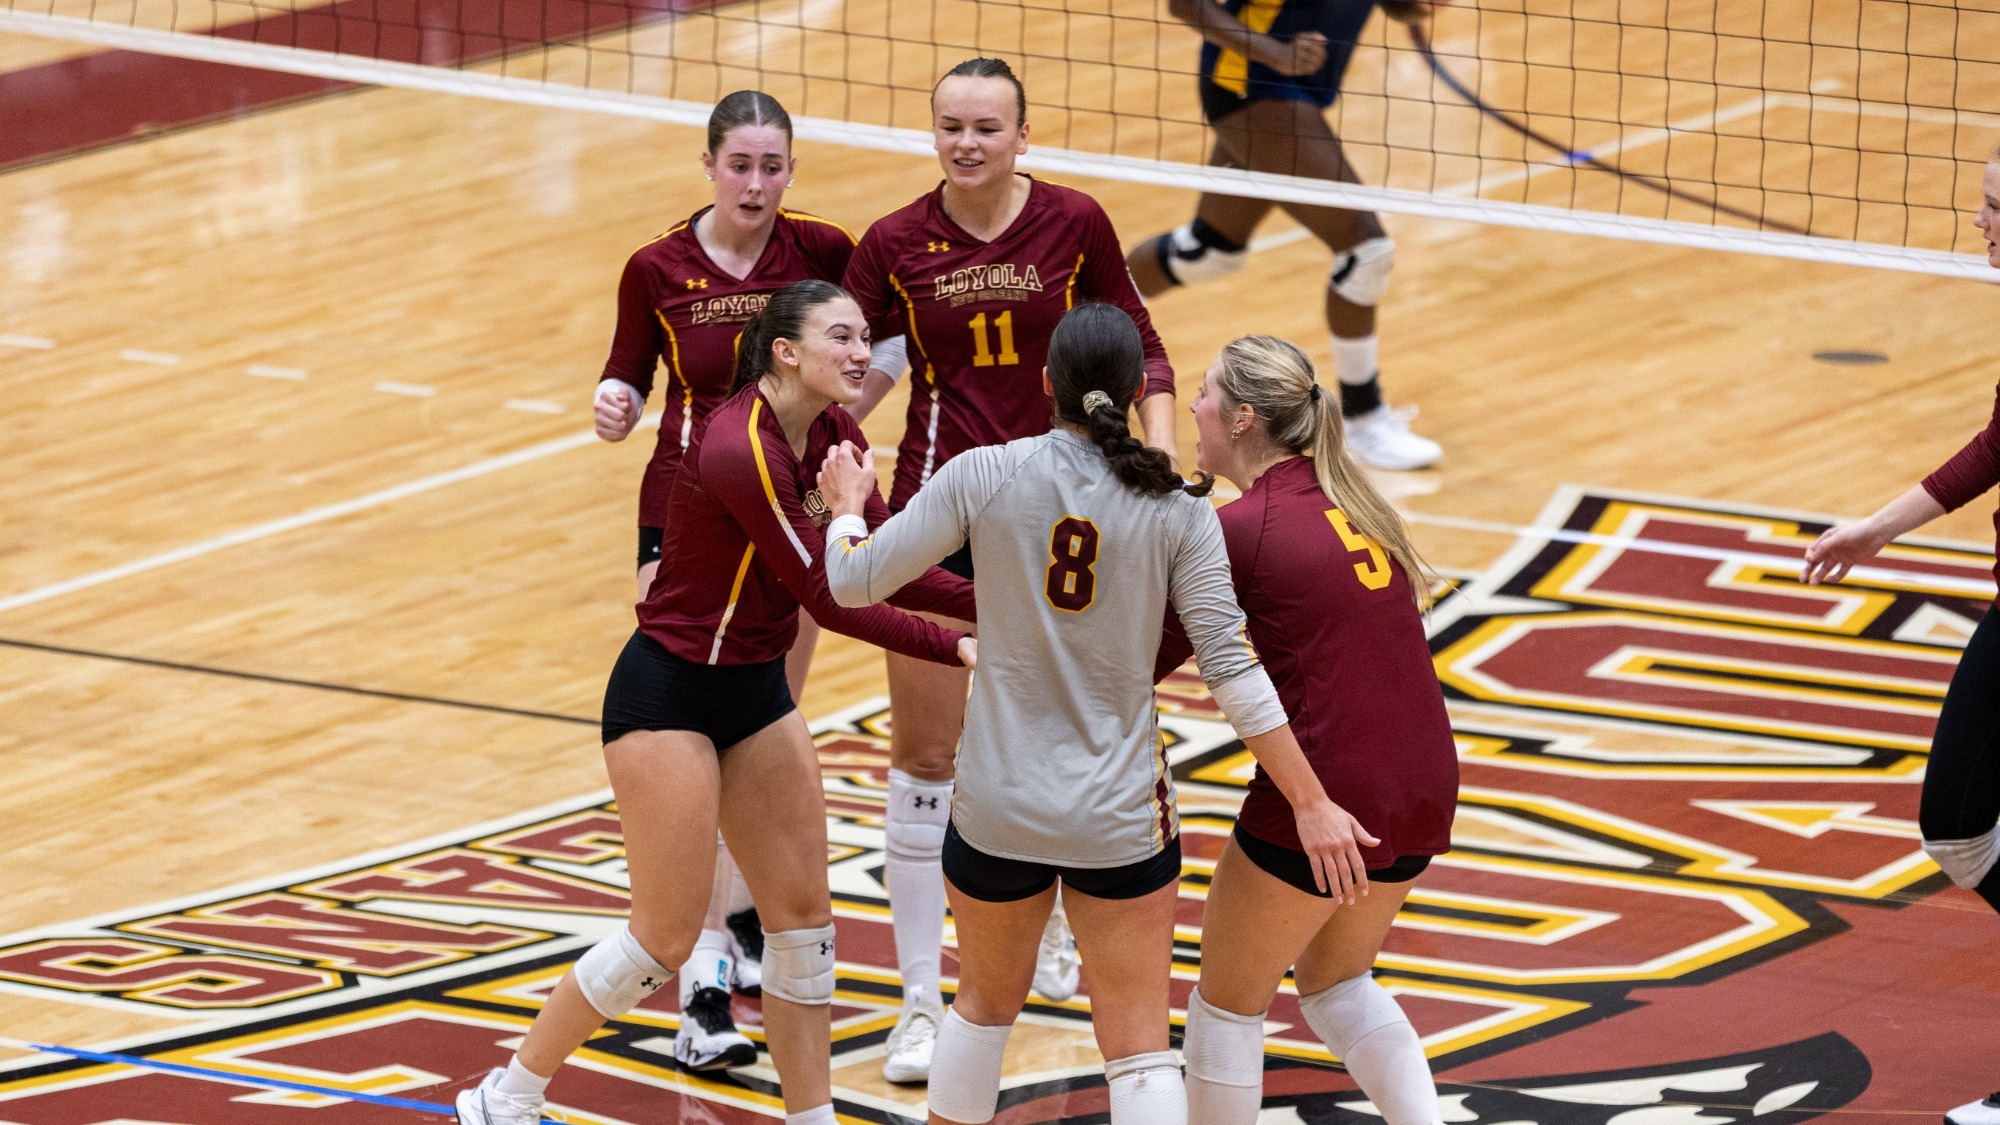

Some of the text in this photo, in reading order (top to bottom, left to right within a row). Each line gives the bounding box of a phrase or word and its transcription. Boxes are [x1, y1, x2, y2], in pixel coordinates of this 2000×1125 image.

[934, 263, 1043, 301] LOYOLA
[968, 310, 1019, 367] 11
[1043, 513, 1102, 615] 8
[1323, 508, 1393, 591] 5
